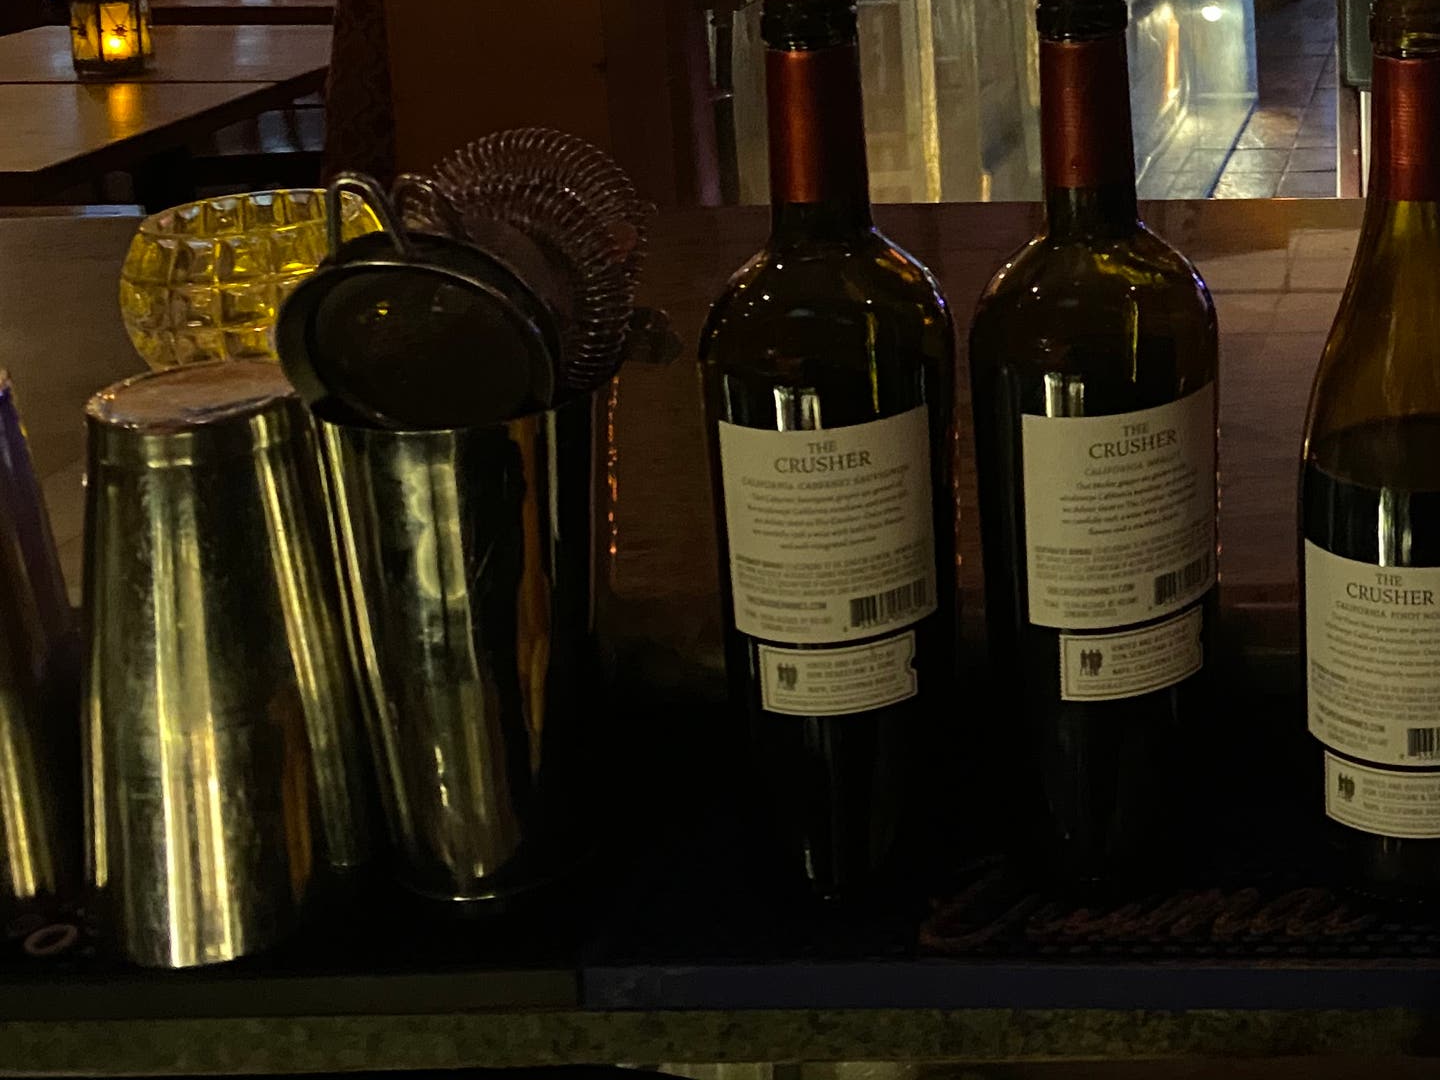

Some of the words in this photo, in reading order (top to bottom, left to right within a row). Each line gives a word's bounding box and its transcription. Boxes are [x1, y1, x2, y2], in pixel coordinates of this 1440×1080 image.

[1122, 422, 1149, 437] THE
[808, 440, 838, 454] THE
[1088, 429, 1178, 459] CRUSHER
[774, 450, 872, 474] CRUSHER
[1375, 573, 1402, 587] THE
[1346, 582, 1434, 606] CRUSHER
